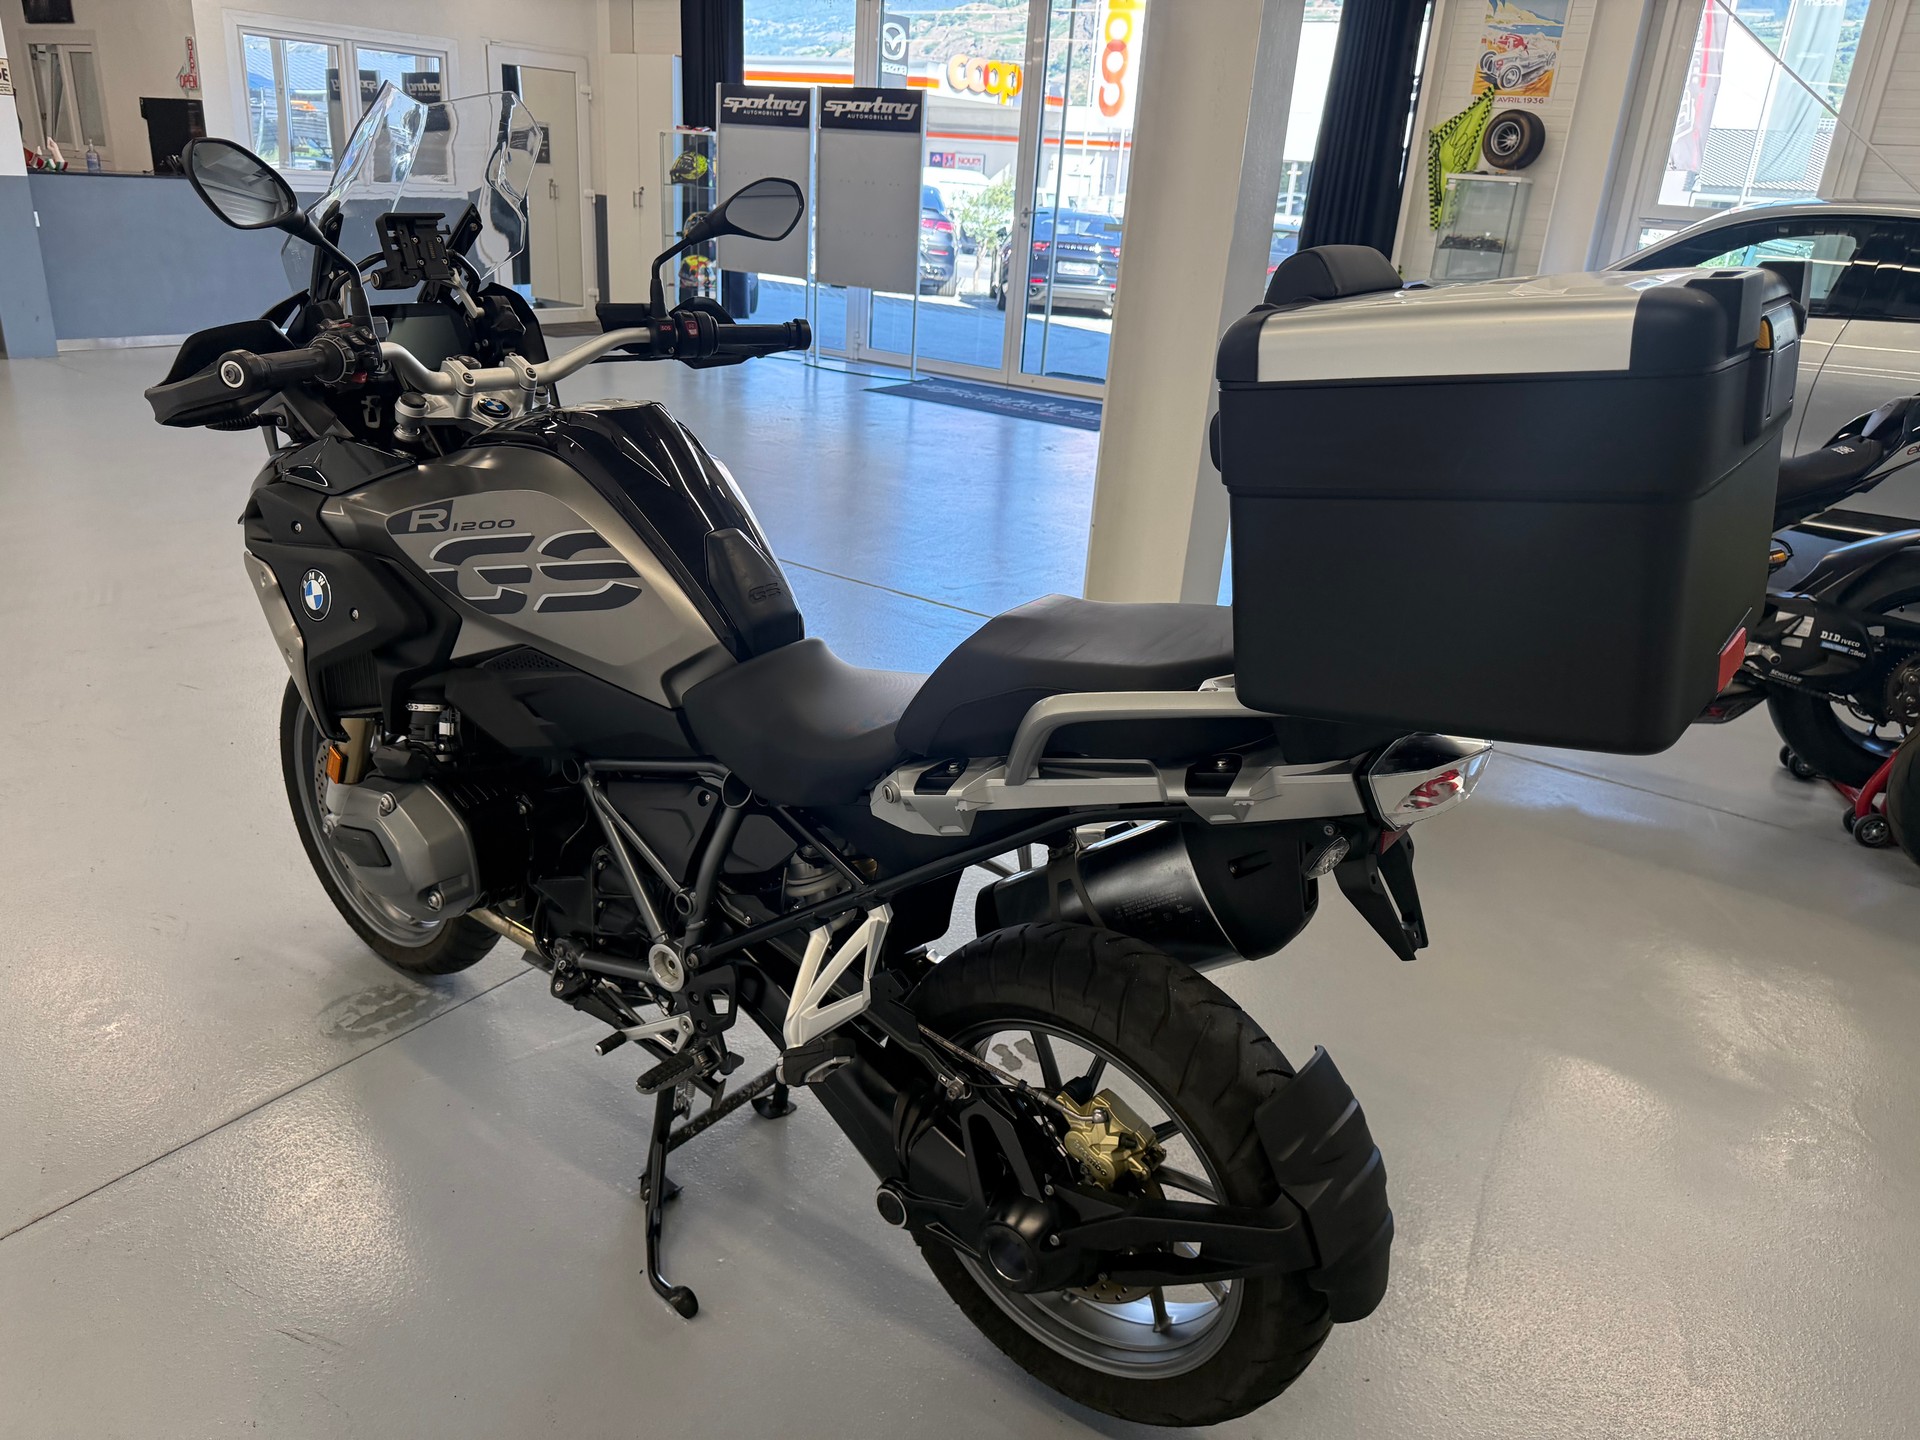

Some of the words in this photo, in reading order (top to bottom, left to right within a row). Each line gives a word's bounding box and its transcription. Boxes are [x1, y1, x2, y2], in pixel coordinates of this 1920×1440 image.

[180, 74, 198, 89] OPEN
[948, 54, 1023, 106] coop
[722, 93, 807, 117] sporting
[823, 96, 919, 121] sporting
[1497, 96, 1523, 104] AVRIL
[1523, 97, 1544, 105] 1936
[743, 109, 783, 117] AUTOMOBILES
[847, 113, 892, 121] AUTOMOBILES
[408, 508, 449, 533] R
[452, 518, 516, 533] 1200
[302, 571, 326, 589] BMW
[425, 529, 643, 615] GS
[1841, 638, 1860, 648] IVECO
